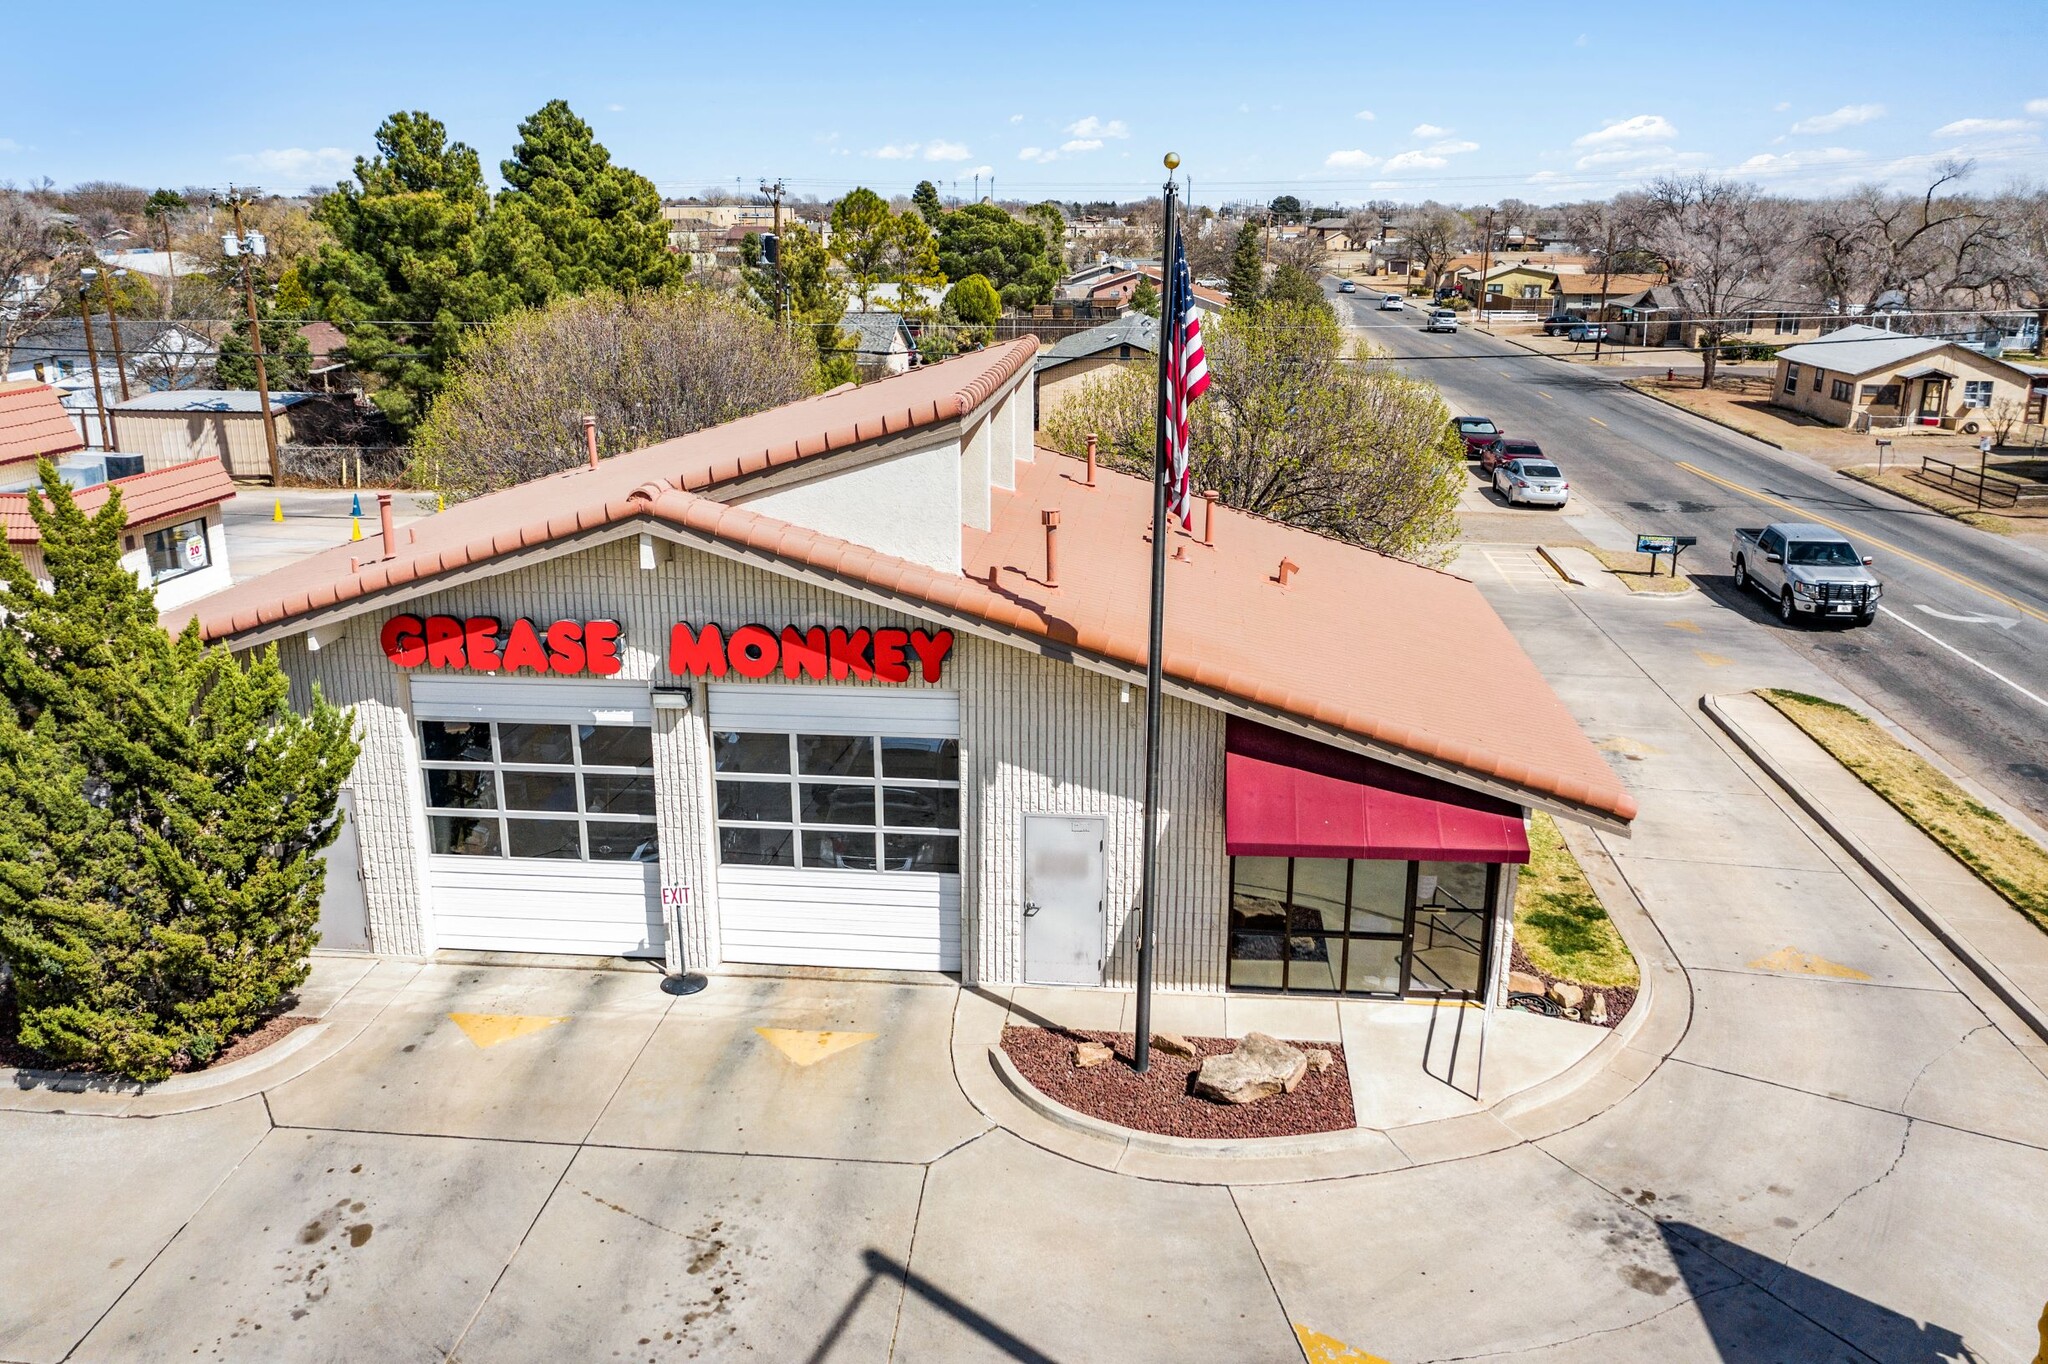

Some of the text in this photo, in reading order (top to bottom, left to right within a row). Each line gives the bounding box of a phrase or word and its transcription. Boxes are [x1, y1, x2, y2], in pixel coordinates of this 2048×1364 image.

[381, 613, 954, 684] GREASE MONKEY
[662, 887, 690, 905] EXIT
